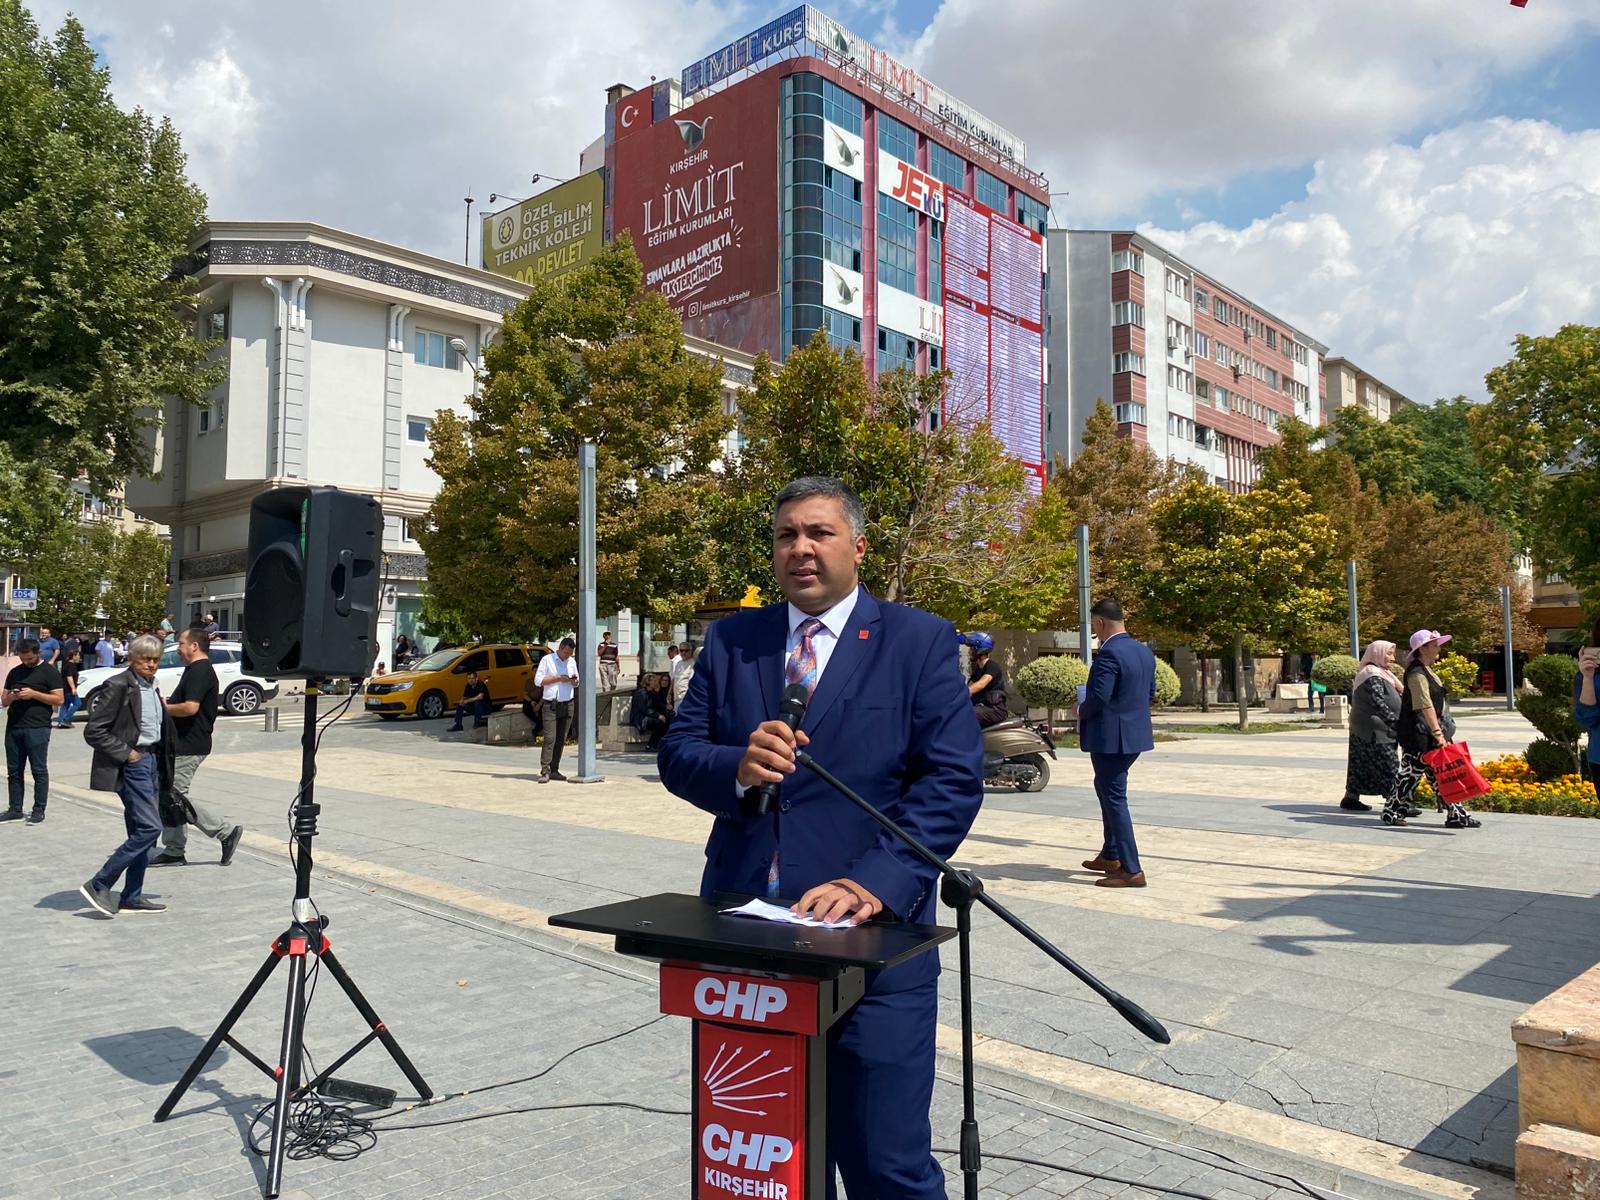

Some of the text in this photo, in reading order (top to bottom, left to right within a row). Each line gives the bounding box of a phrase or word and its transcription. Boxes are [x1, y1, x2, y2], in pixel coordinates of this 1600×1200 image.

[763, 21, 802, 54] KURS
[938, 103, 968, 130] EĞİTİM
[669, 149, 709, 175] KIRŞEHİR
[643, 161, 744, 236] LİMİT
[892, 161, 942, 208] JET
[522, 201, 593, 240] OSB BİLİM
[523, 201, 556, 225] ÖZEL
[923, 192, 944, 219] KÜ
[495, 215, 592, 266] TEKNİK KOLEJİ
[648, 206, 732, 247] EĞİTİM KURUMLARI
[537, 239, 585, 276] DEVLET
[686, 231, 732, 265] HAZIRLIKTA
[694, 977, 787, 1022] CHP
[702, 1123, 793, 1172] CHP
[704, 1167, 788, 1200] KIRŞEHİR
